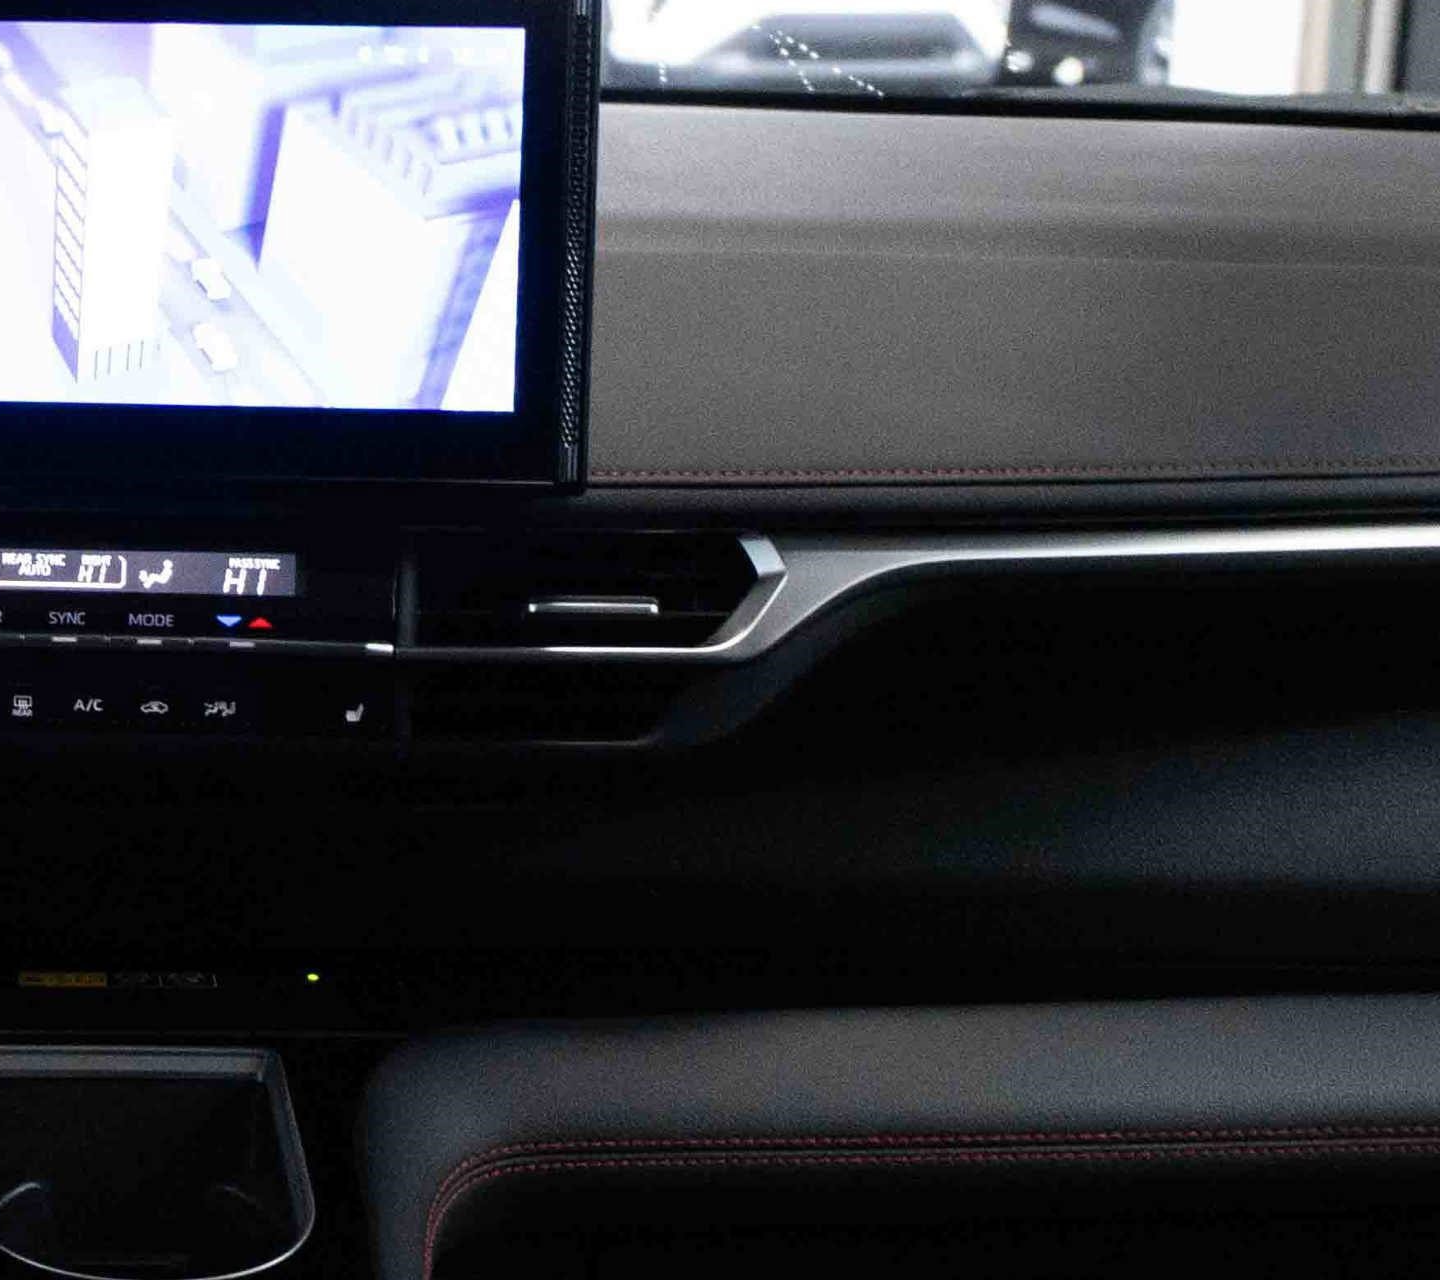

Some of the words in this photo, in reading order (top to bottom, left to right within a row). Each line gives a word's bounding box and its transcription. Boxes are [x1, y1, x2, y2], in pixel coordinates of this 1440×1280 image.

[18, 564, 51, 577] AUTO
[48, 610, 86, 626] SYNC
[128, 613, 175, 628] MODE
[73, 697, 104, 712] A/C
